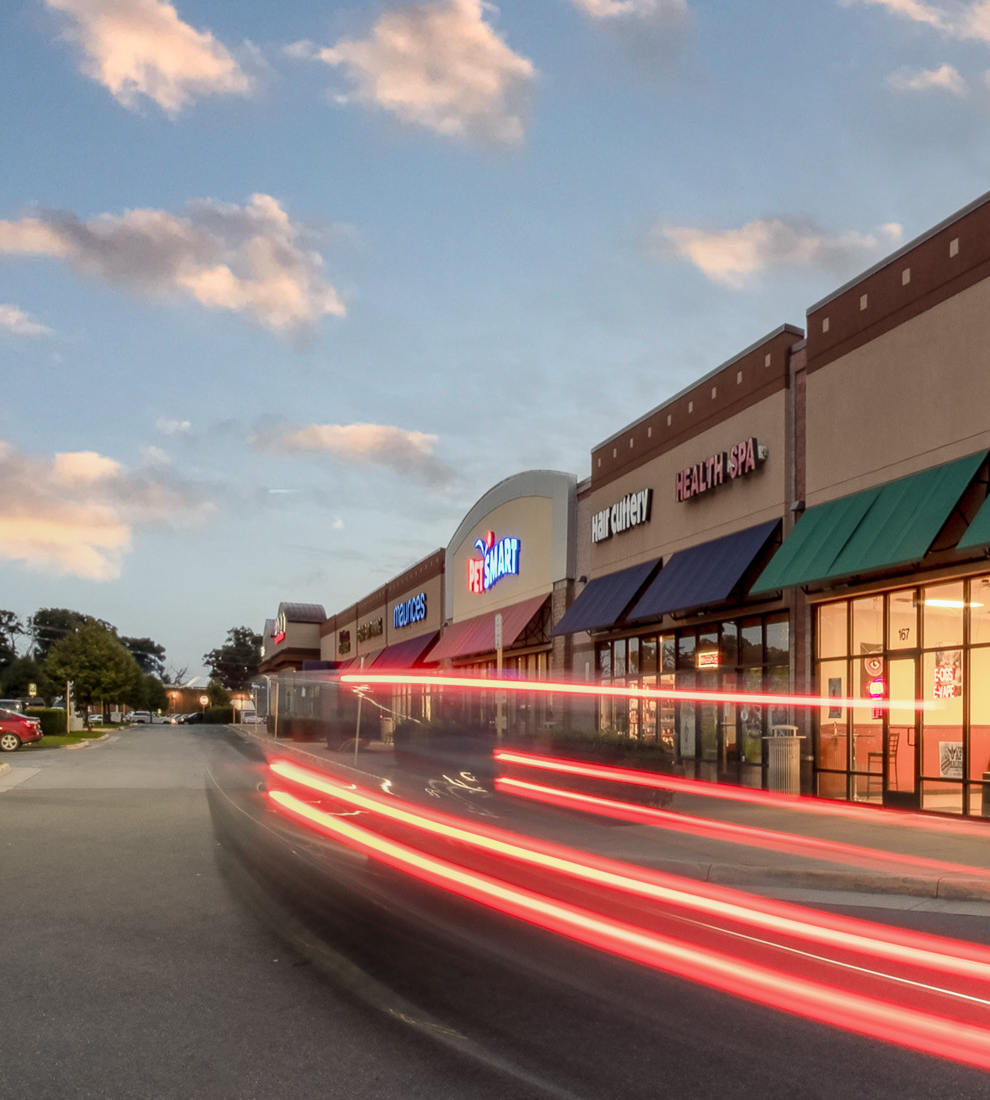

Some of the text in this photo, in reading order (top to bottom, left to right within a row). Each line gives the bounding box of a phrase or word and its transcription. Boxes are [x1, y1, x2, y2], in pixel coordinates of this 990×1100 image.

[675, 437, 757, 502] HEALTH SPA
[592, 507, 610, 543] Hair
[898, 627, 910, 641] 167
